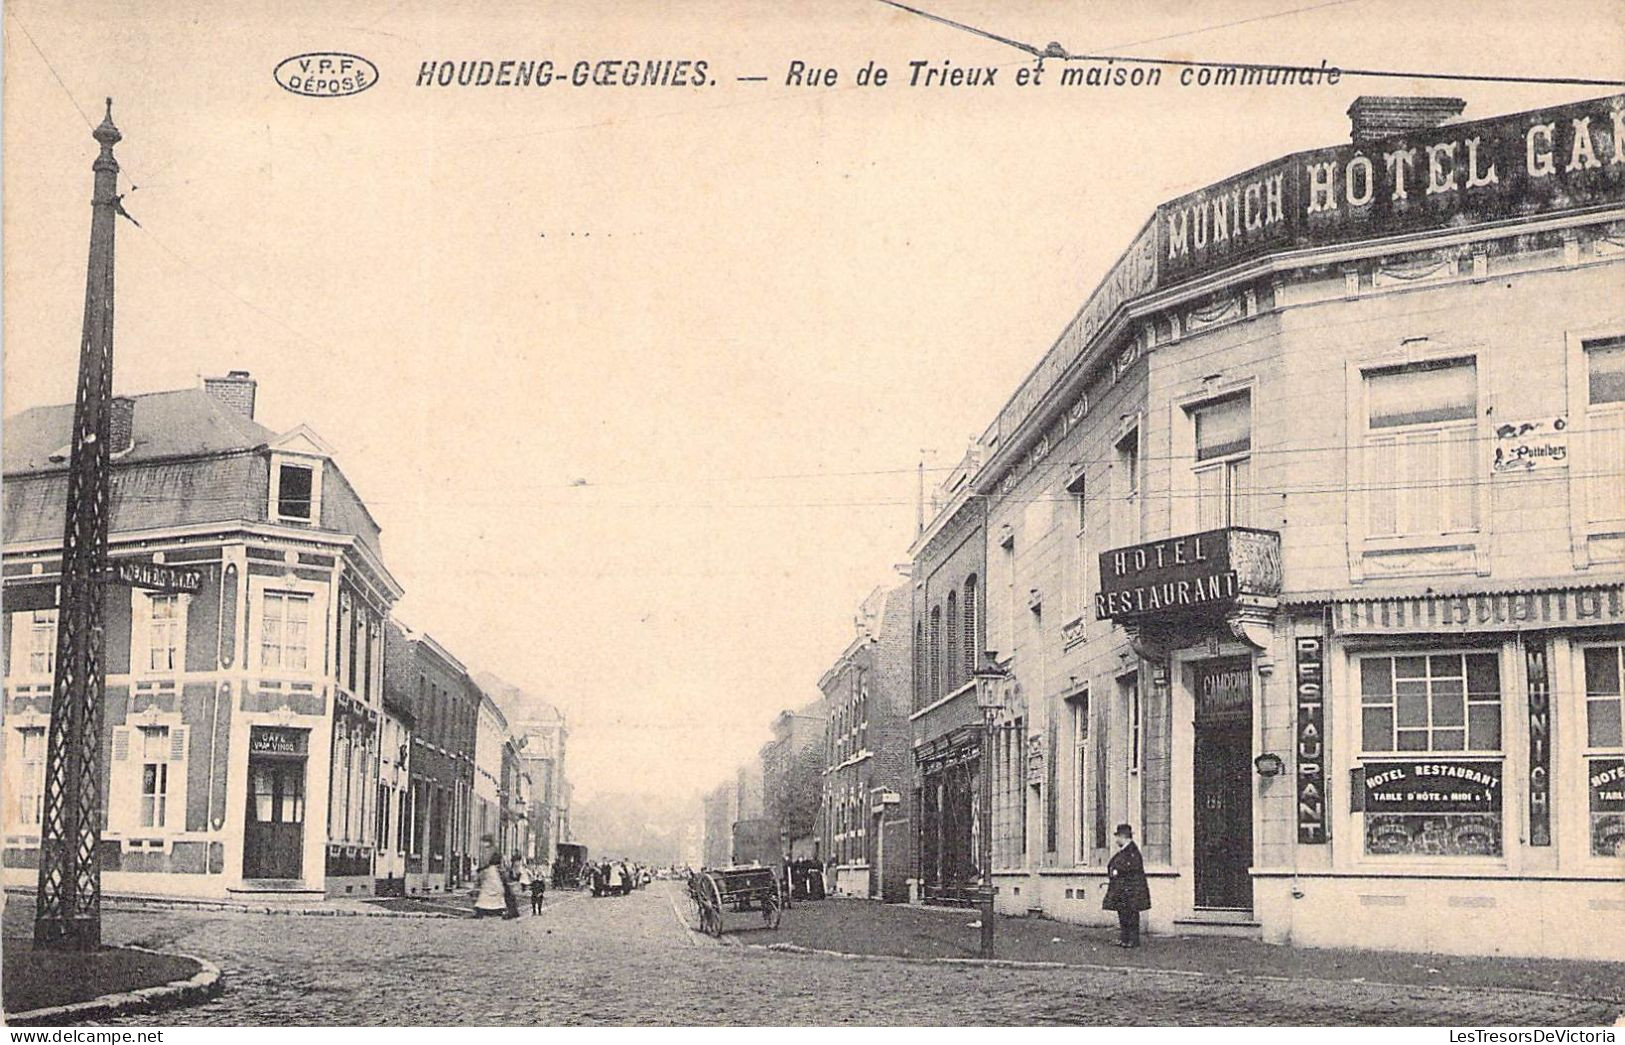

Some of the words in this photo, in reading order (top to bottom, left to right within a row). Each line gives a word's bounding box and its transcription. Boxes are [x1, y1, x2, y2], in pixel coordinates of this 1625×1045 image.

[1114, 538, 1207, 576] HOTEL
[1095, 572, 1235, 618] RESTAURANT
[1299, 638, 1322, 840] RESTAURANT
[1526, 652, 1547, 815] MUNICH
[1366, 768, 1406, 789] HOTEL
[1415, 764, 1499, 788] RESTAURANT
[1373, 792, 1403, 801] TABLE
[1450, 792, 1472, 801] MIDI
